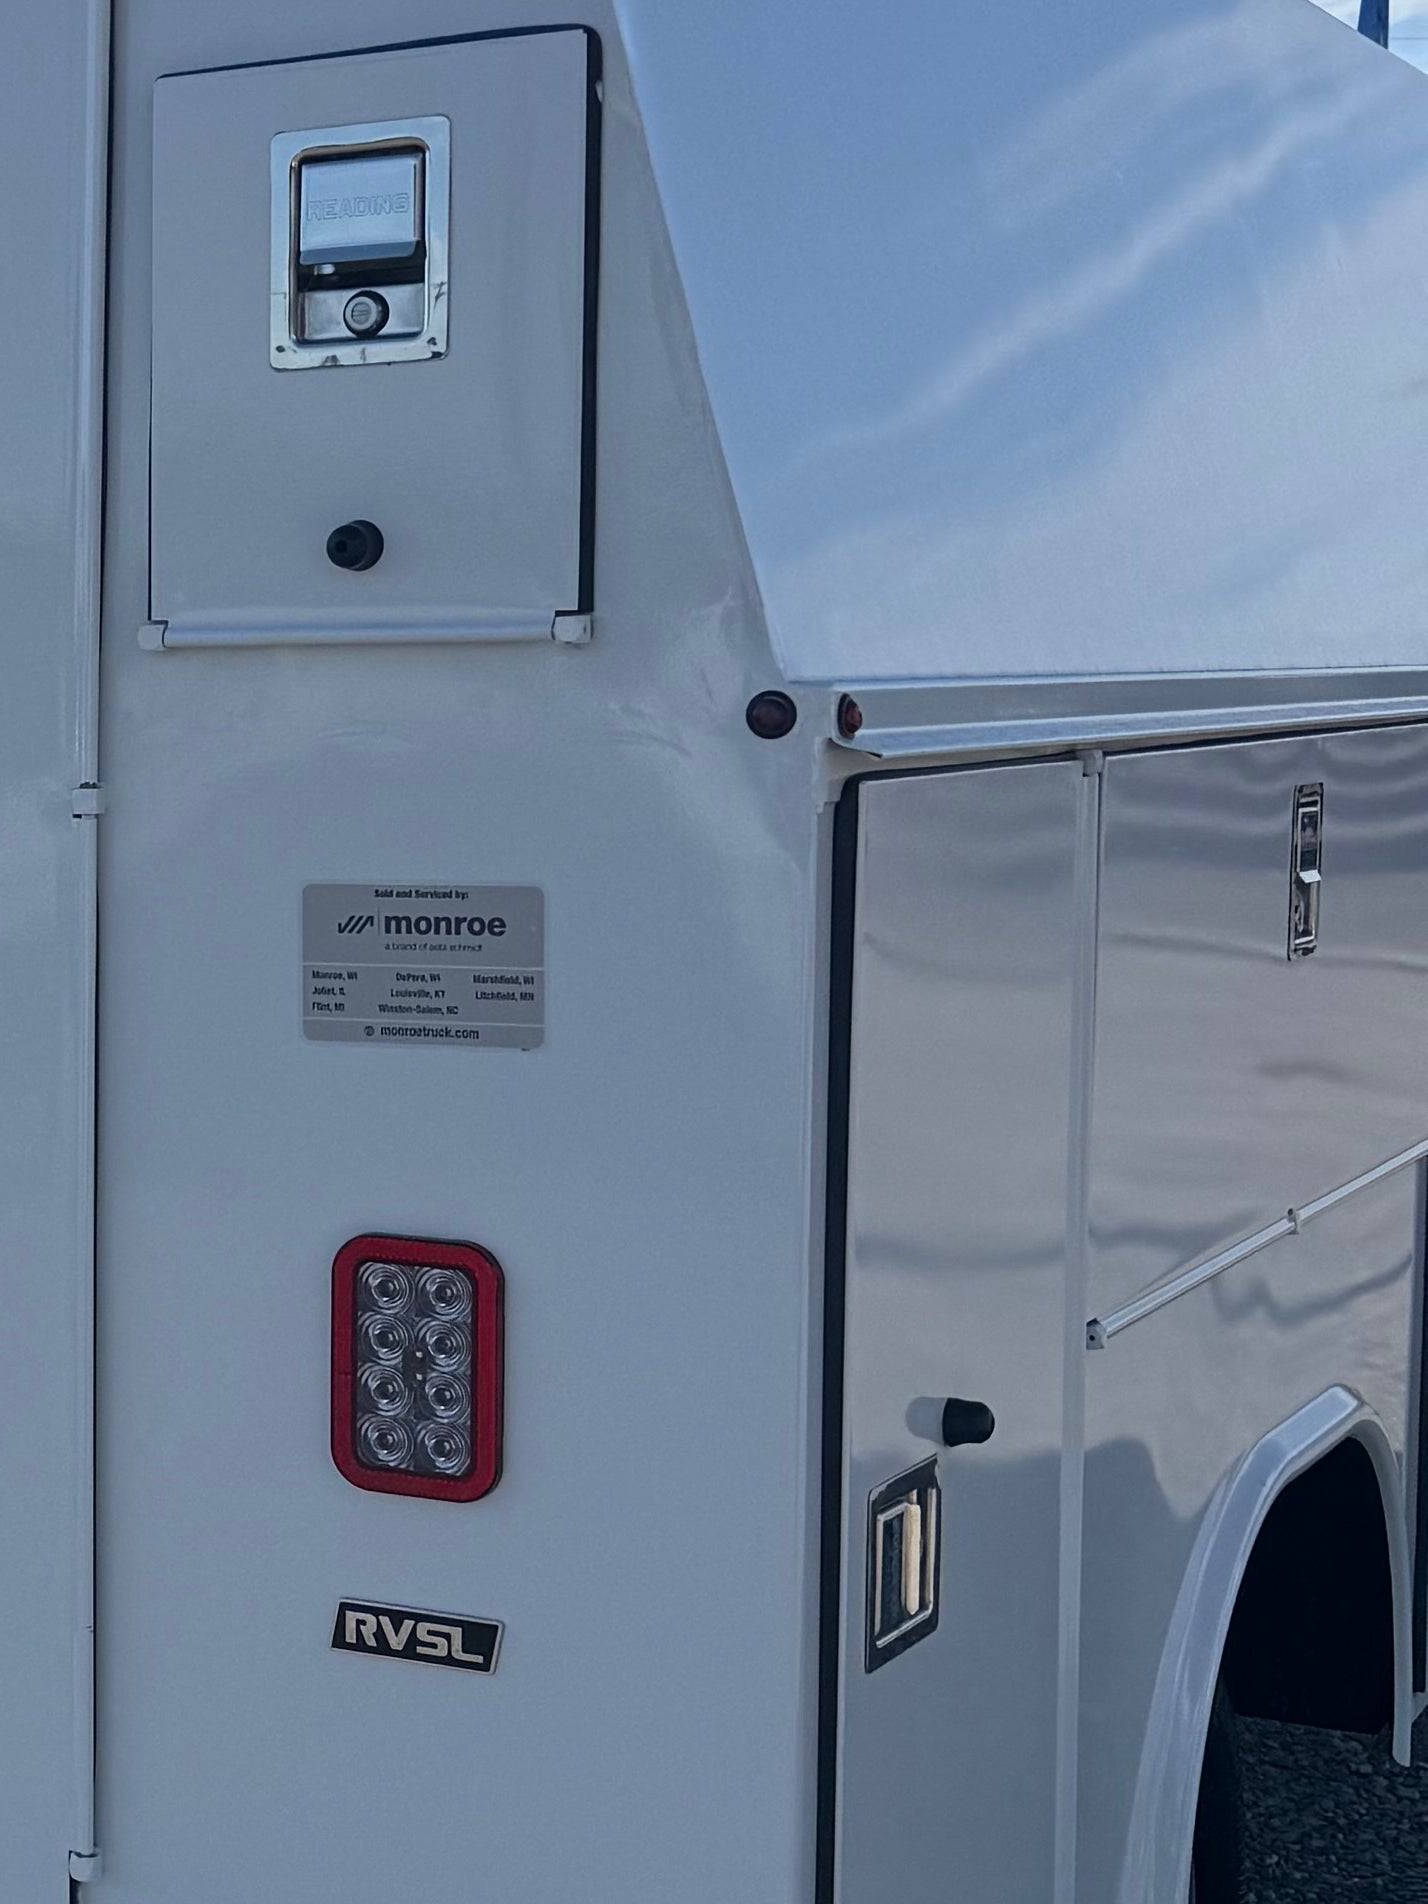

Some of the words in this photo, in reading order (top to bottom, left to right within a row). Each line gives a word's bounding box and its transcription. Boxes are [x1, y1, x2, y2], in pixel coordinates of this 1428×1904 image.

[306, 192, 410, 222] READING
[384, 915, 507, 937] monroe
[344, 1609, 485, 1665] RVSL
